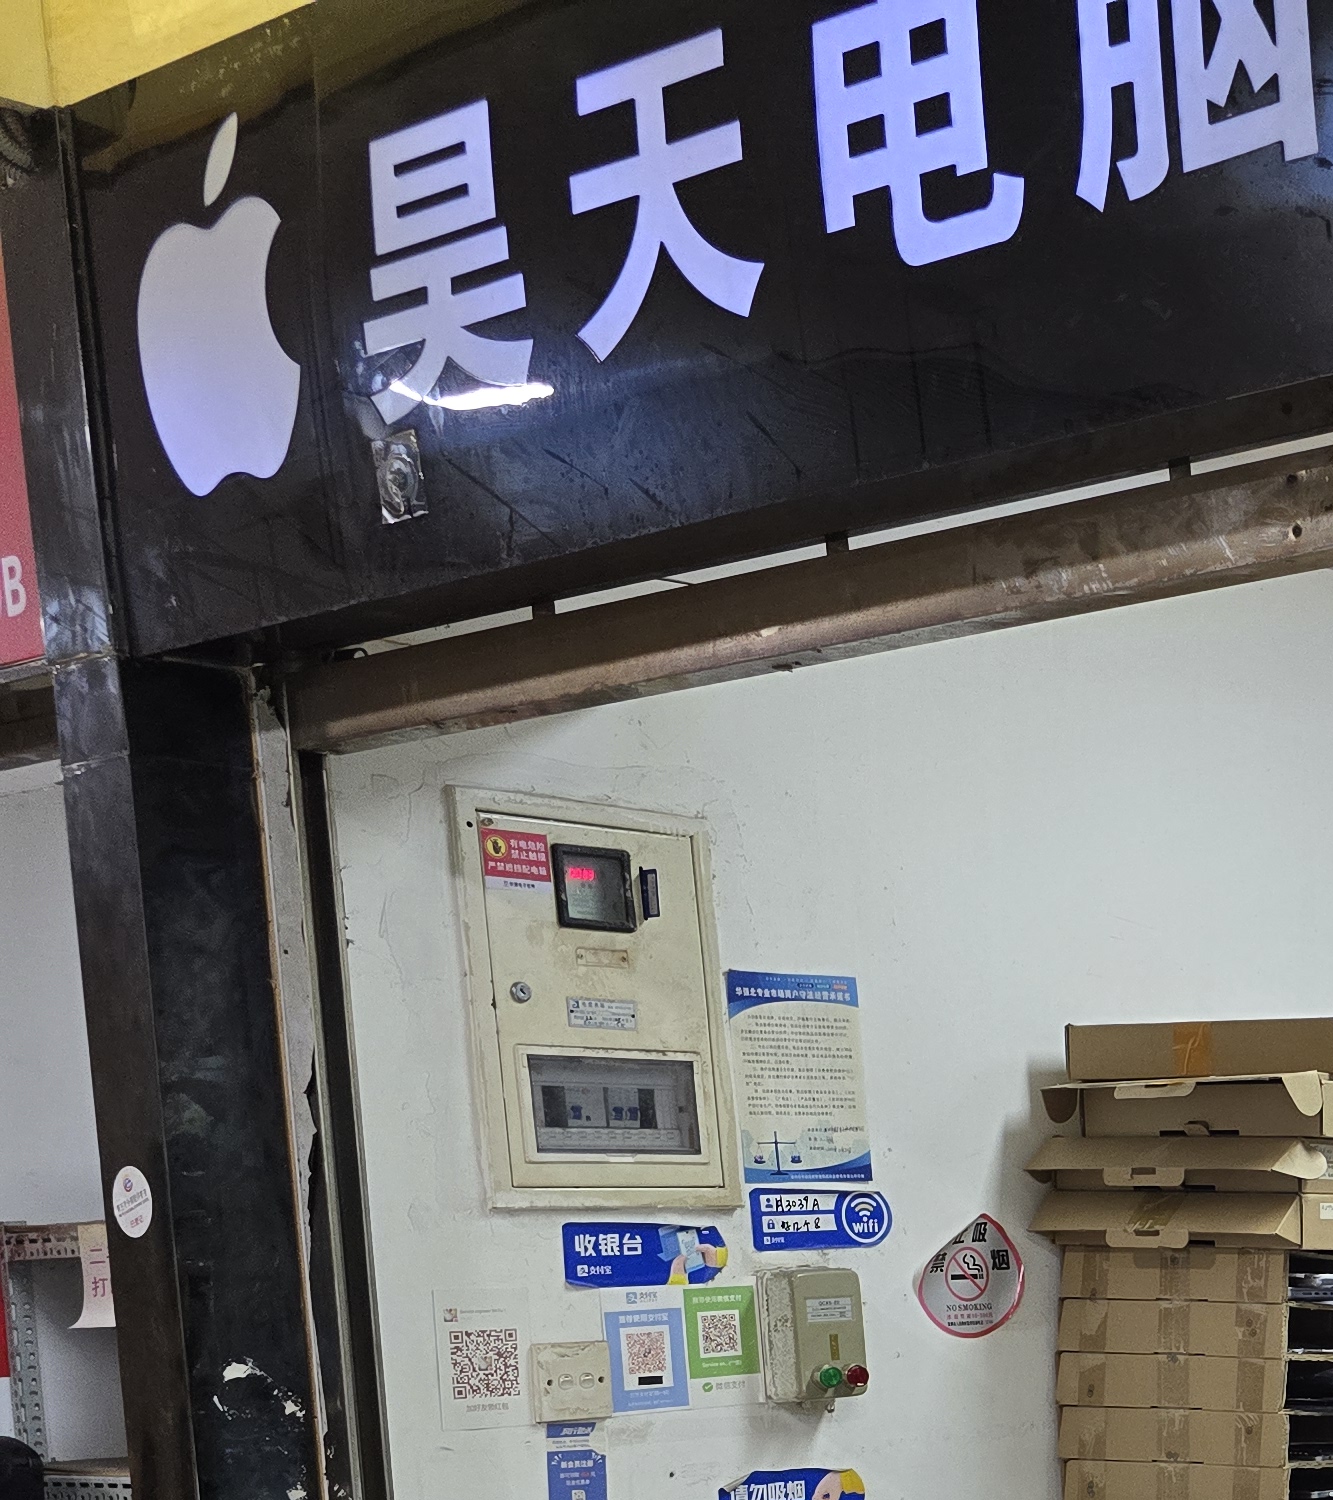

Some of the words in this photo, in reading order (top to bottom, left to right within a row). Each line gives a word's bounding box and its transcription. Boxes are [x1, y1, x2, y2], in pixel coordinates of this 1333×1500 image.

[510, 839, 545, 852] 有电危险
[852, 1217, 879, 1234] wifi
[574, 1233, 643, 1257] 收银台
[589, 1265, 612, 1275] 支付宝
[946, 1304, 957, 1312] NO
[958, 1303, 992, 1311] SMOKING
[716, 1381, 745, 1390] 微信支付
